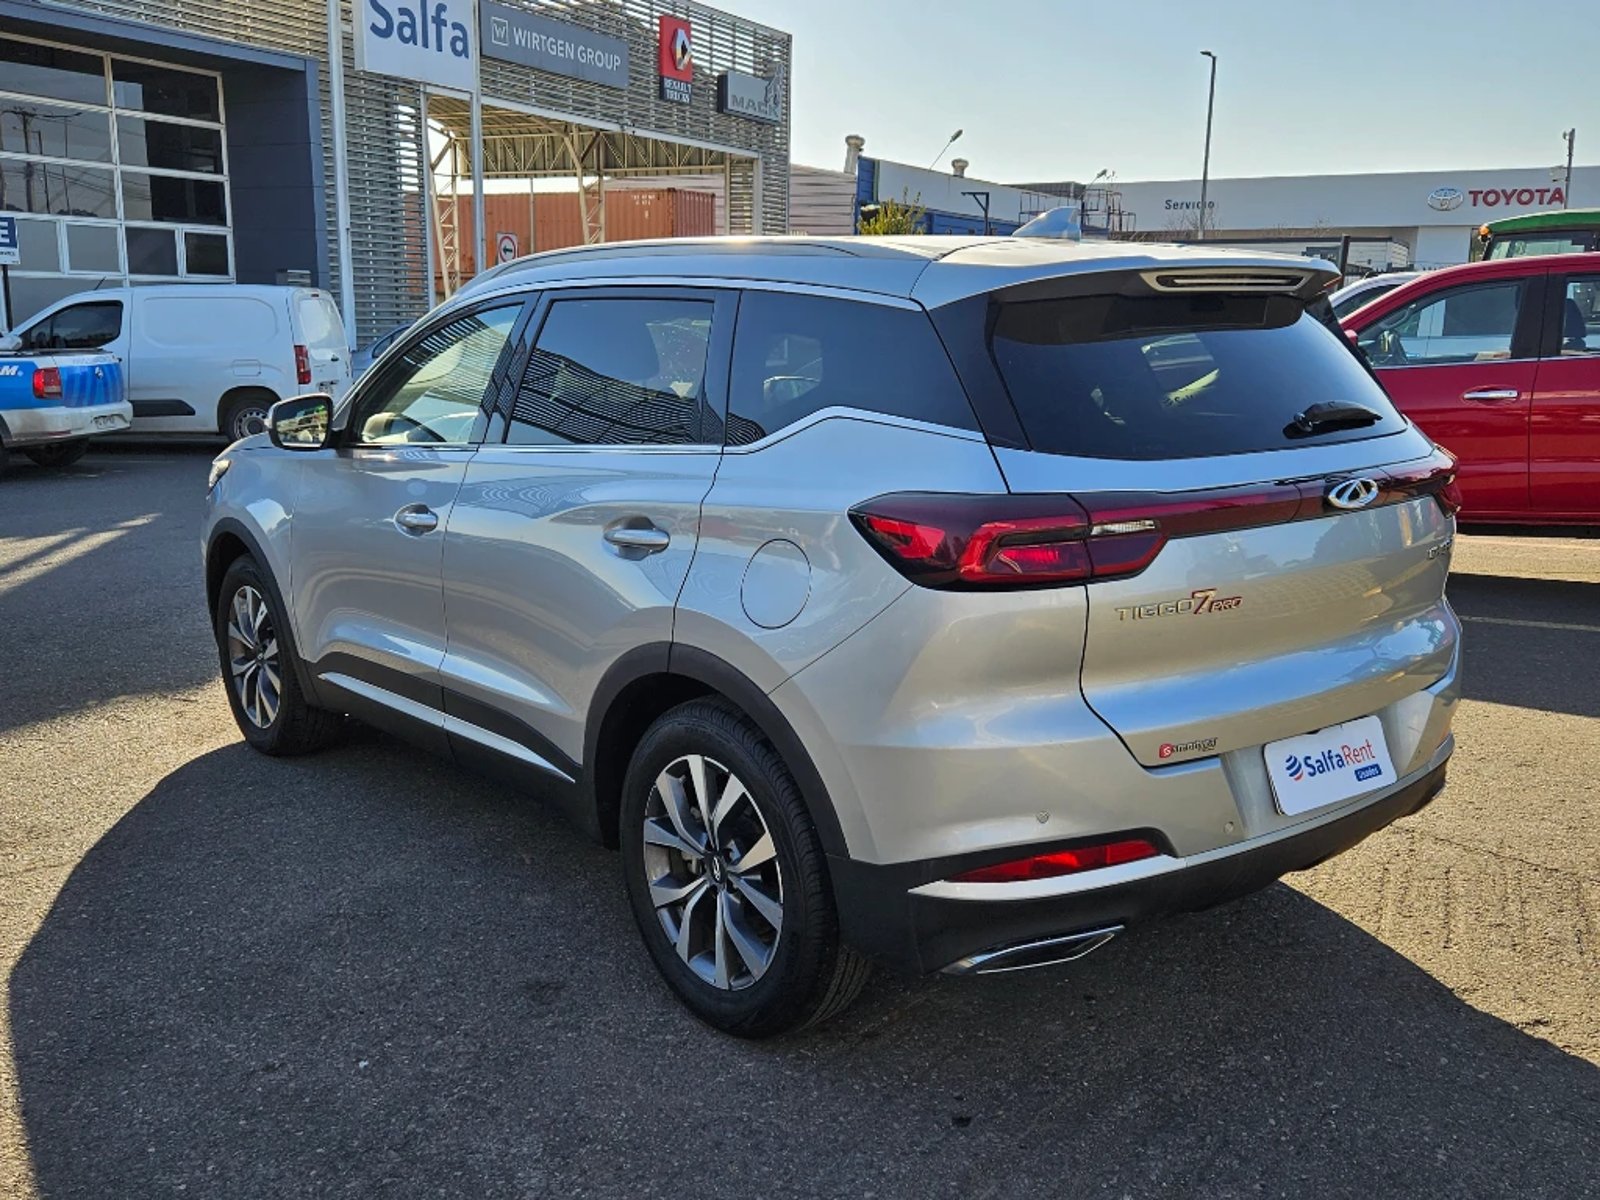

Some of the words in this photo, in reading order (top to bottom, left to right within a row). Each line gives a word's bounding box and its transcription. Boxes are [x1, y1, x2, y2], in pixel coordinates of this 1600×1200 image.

[370, 0, 469, 59] Salfa
[514, 26, 574, 60] WIRTGEN
[577, 45, 621, 71] GROUP
[1468, 187, 1565, 207] TOYOTA
[1303, 739, 1376, 777] SalfaRent
